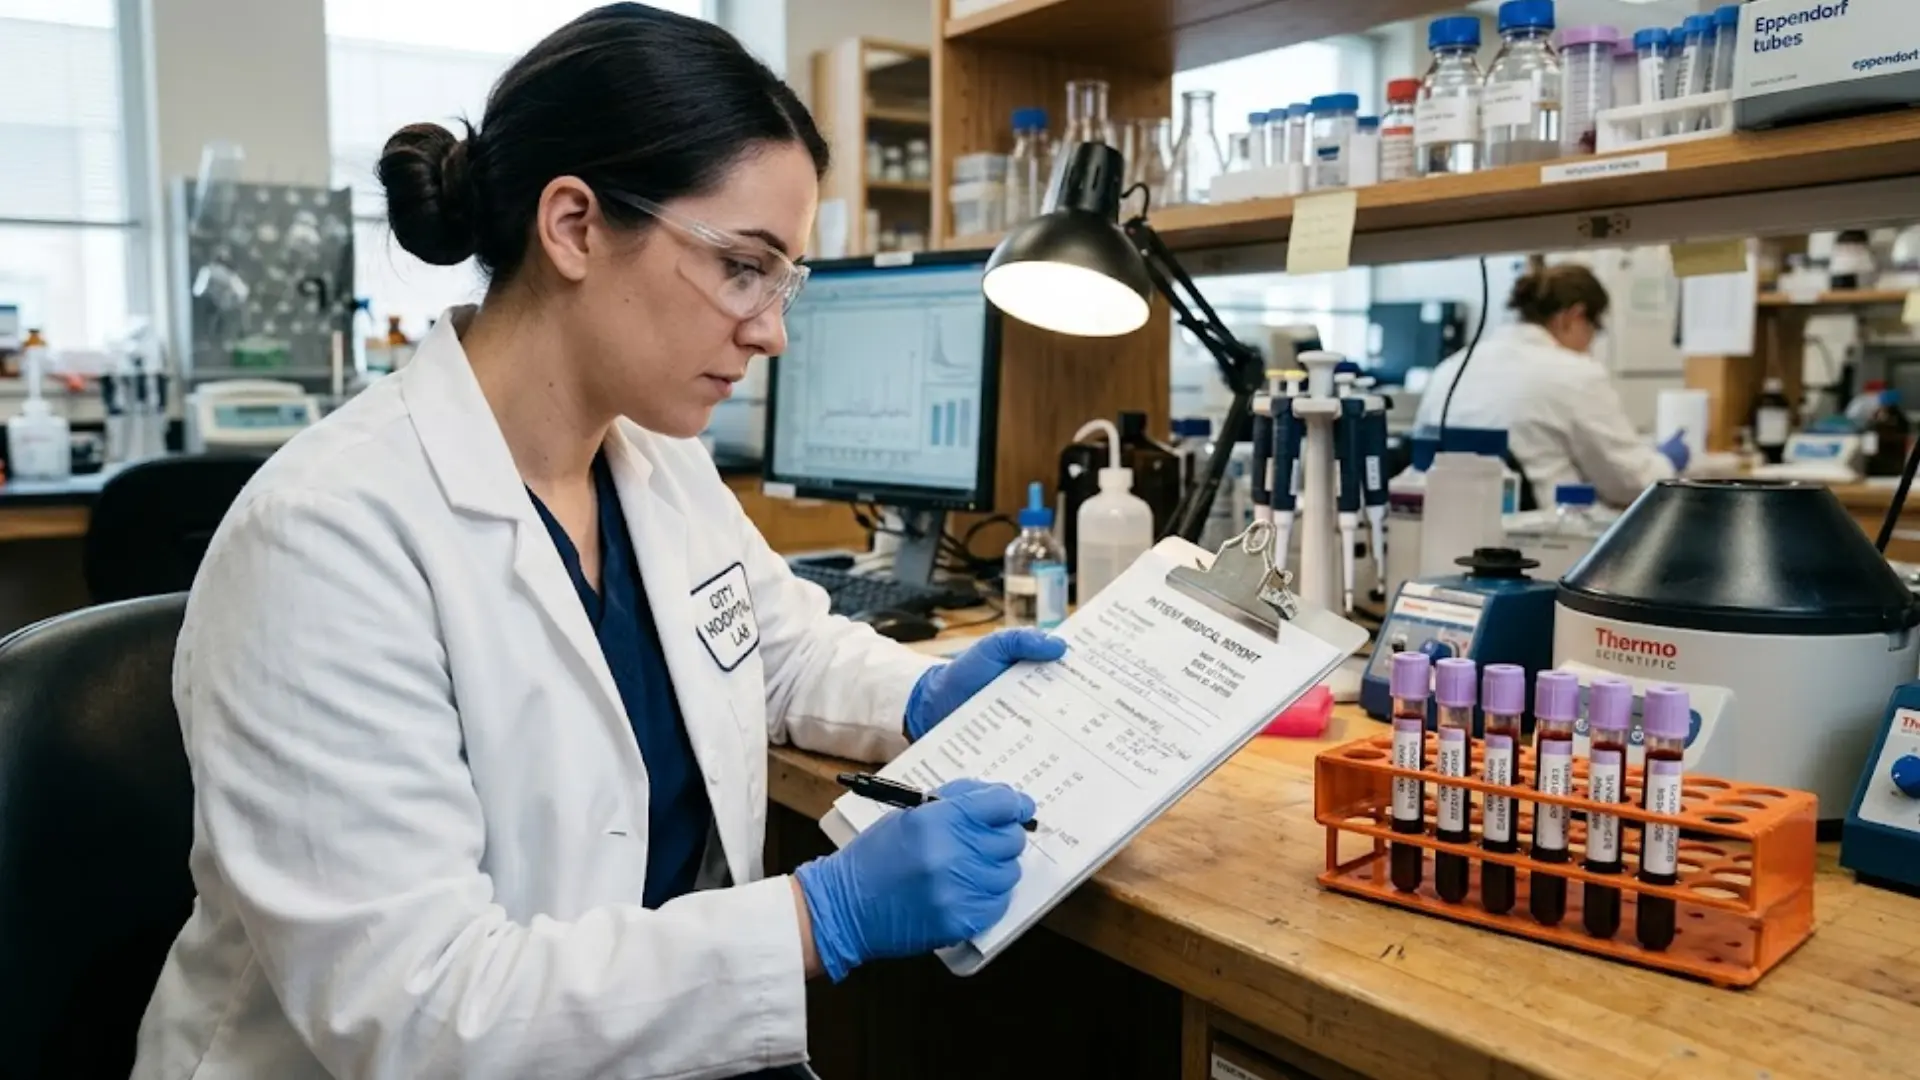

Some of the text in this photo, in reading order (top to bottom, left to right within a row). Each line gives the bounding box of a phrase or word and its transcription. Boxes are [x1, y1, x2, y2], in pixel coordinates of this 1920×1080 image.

[1755, 0, 1849, 35] Eppendorf
[1754, 32, 1803, 54] tubes
[1595, 627, 1677, 658] Thermo
[1595, 649, 1677, 670] SCIENTIFIC
